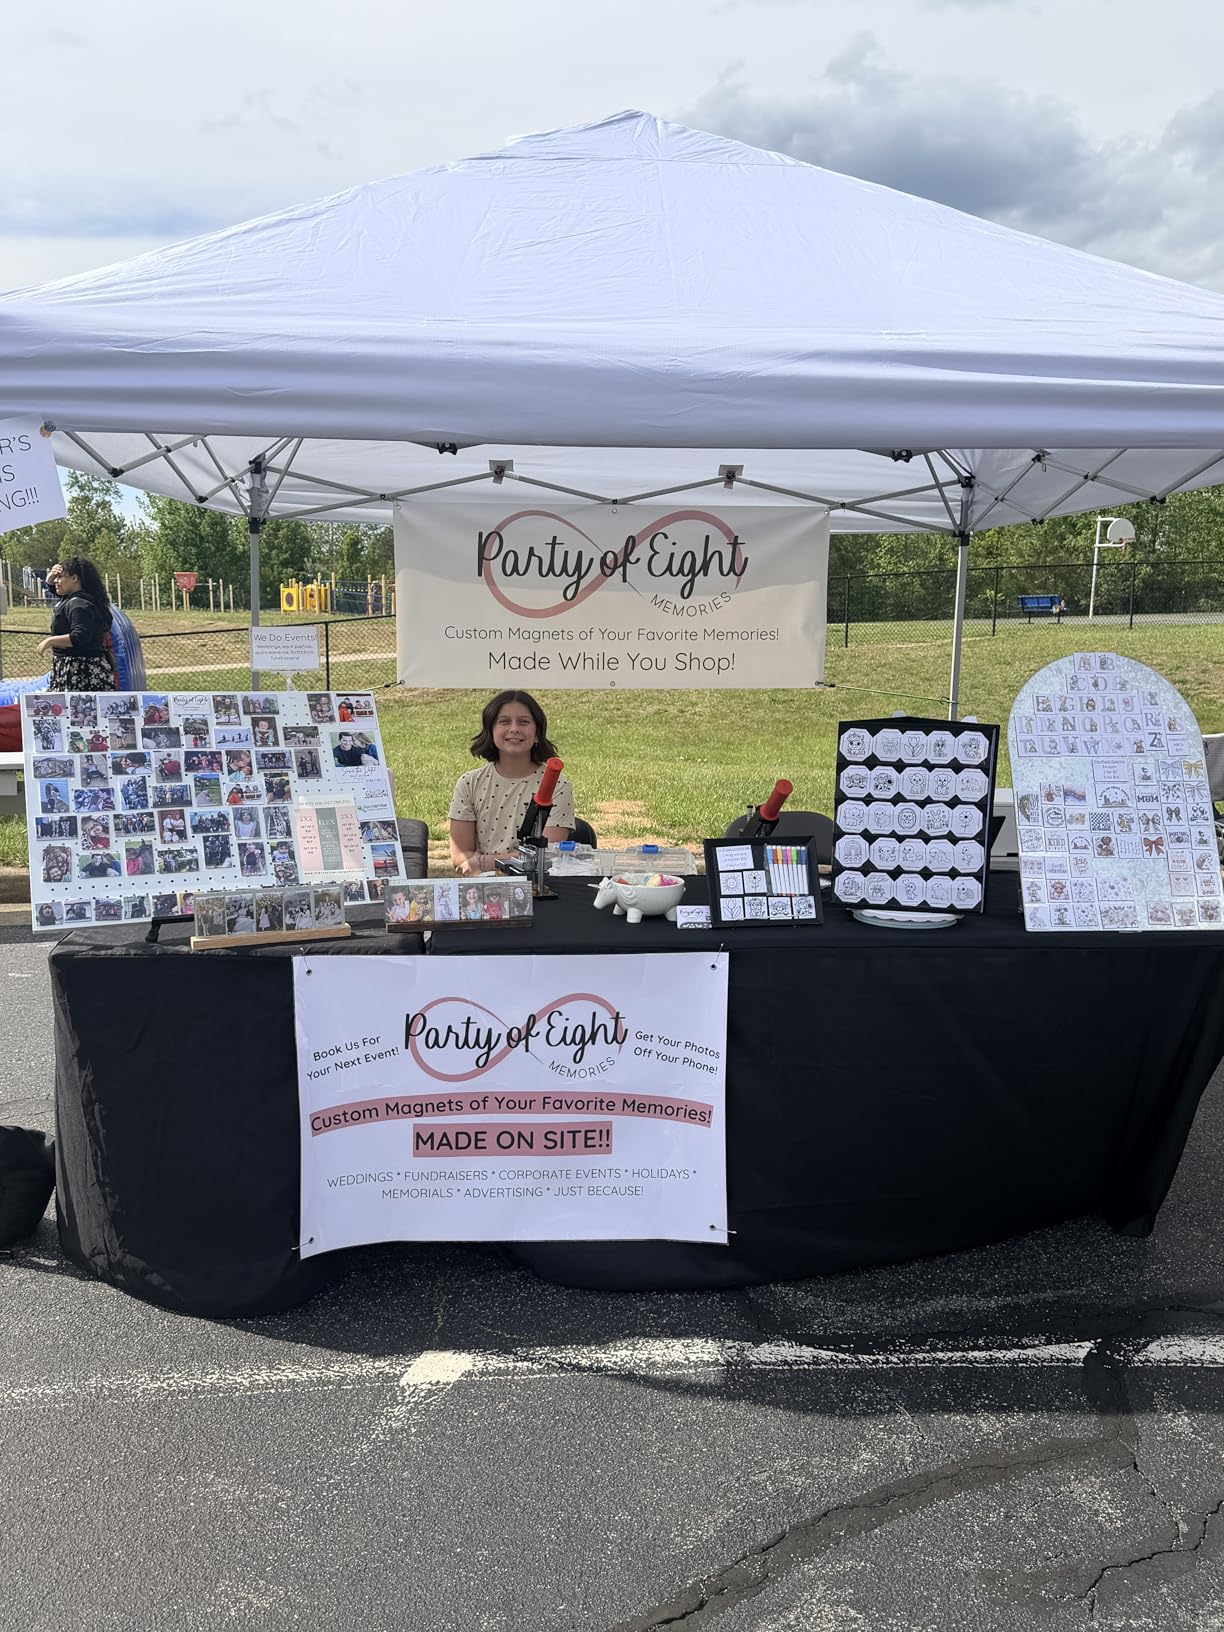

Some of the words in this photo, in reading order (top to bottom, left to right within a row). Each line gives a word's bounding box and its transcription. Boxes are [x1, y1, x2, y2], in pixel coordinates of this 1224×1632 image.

[0, 464, 15, 484] S
[478, 530, 595, 602] Party
[600, 535, 640, 583] of
[647, 531, 749, 601] Eight
[650, 591, 732, 618] MEMORIES
[254, 633, 266, 642] We
[269, 633, 282, 642] Do
[444, 625, 503, 640] Custom
[508, 627, 574, 643] Magnets
[578, 626, 595, 641] of
[598, 627, 633, 641] Your
[637, 628, 698, 641] Favorite
[703, 627, 779, 641] Memories!
[488, 651, 551, 671] Made
[558, 651, 619, 671] While
[626, 652, 667, 671] You
[674, 651, 736, 676] Shop!
[313, 1045, 344, 1060] Book
[344, 1041, 360, 1051] Us
[361, 1035, 381, 1048] For
[405, 1012, 502, 1069] Party
[507, 1013, 541, 1053] of
[545, 1010, 629, 1065] Eight
[635, 1030, 654, 1043] Get
[657, 1034, 683, 1048] Your
[682, 1041, 721, 1060] Photos
[306, 1066, 331, 1081] Your
[334, 1057, 362, 1071] Next
[363, 1045, 400, 1064] Event!
[548, 1059, 616, 1080] MEMORIES
[633, 1046, 653, 1058] Off
[655, 1050, 681, 1064] Your
[682, 1057, 720, 1075] Phone!
[311, 1107, 379, 1132] Custom
[385, 1099, 464, 1118] Magnets
[469, 1095, 489, 1111] of
[494, 1096, 537, 1111] Your
[542, 1096, 616, 1112] Favorite
[621, 1098, 712, 1124] Memories!
[415, 1130, 488, 1151] MADE
[496, 1130, 535, 1150] ON
[543, 1128, 611, 1150] SITE!!
[327, 1171, 395, 1189] WEDDINGS
[404, 1170, 488, 1182] FUNDRAISERS
[498, 1169, 572, 1181] CORPORATE
[575, 1168, 622, 1180] EVENTS
[632, 1168, 691, 1180] HOLIDAYS
[382, 1187, 454, 1199] MEMORIALS
[463, 1186, 544, 1199] ADVERTISING
[553, 1185, 584, 1197] JUST
[587, 1184, 645, 1197] BECAUSE!
